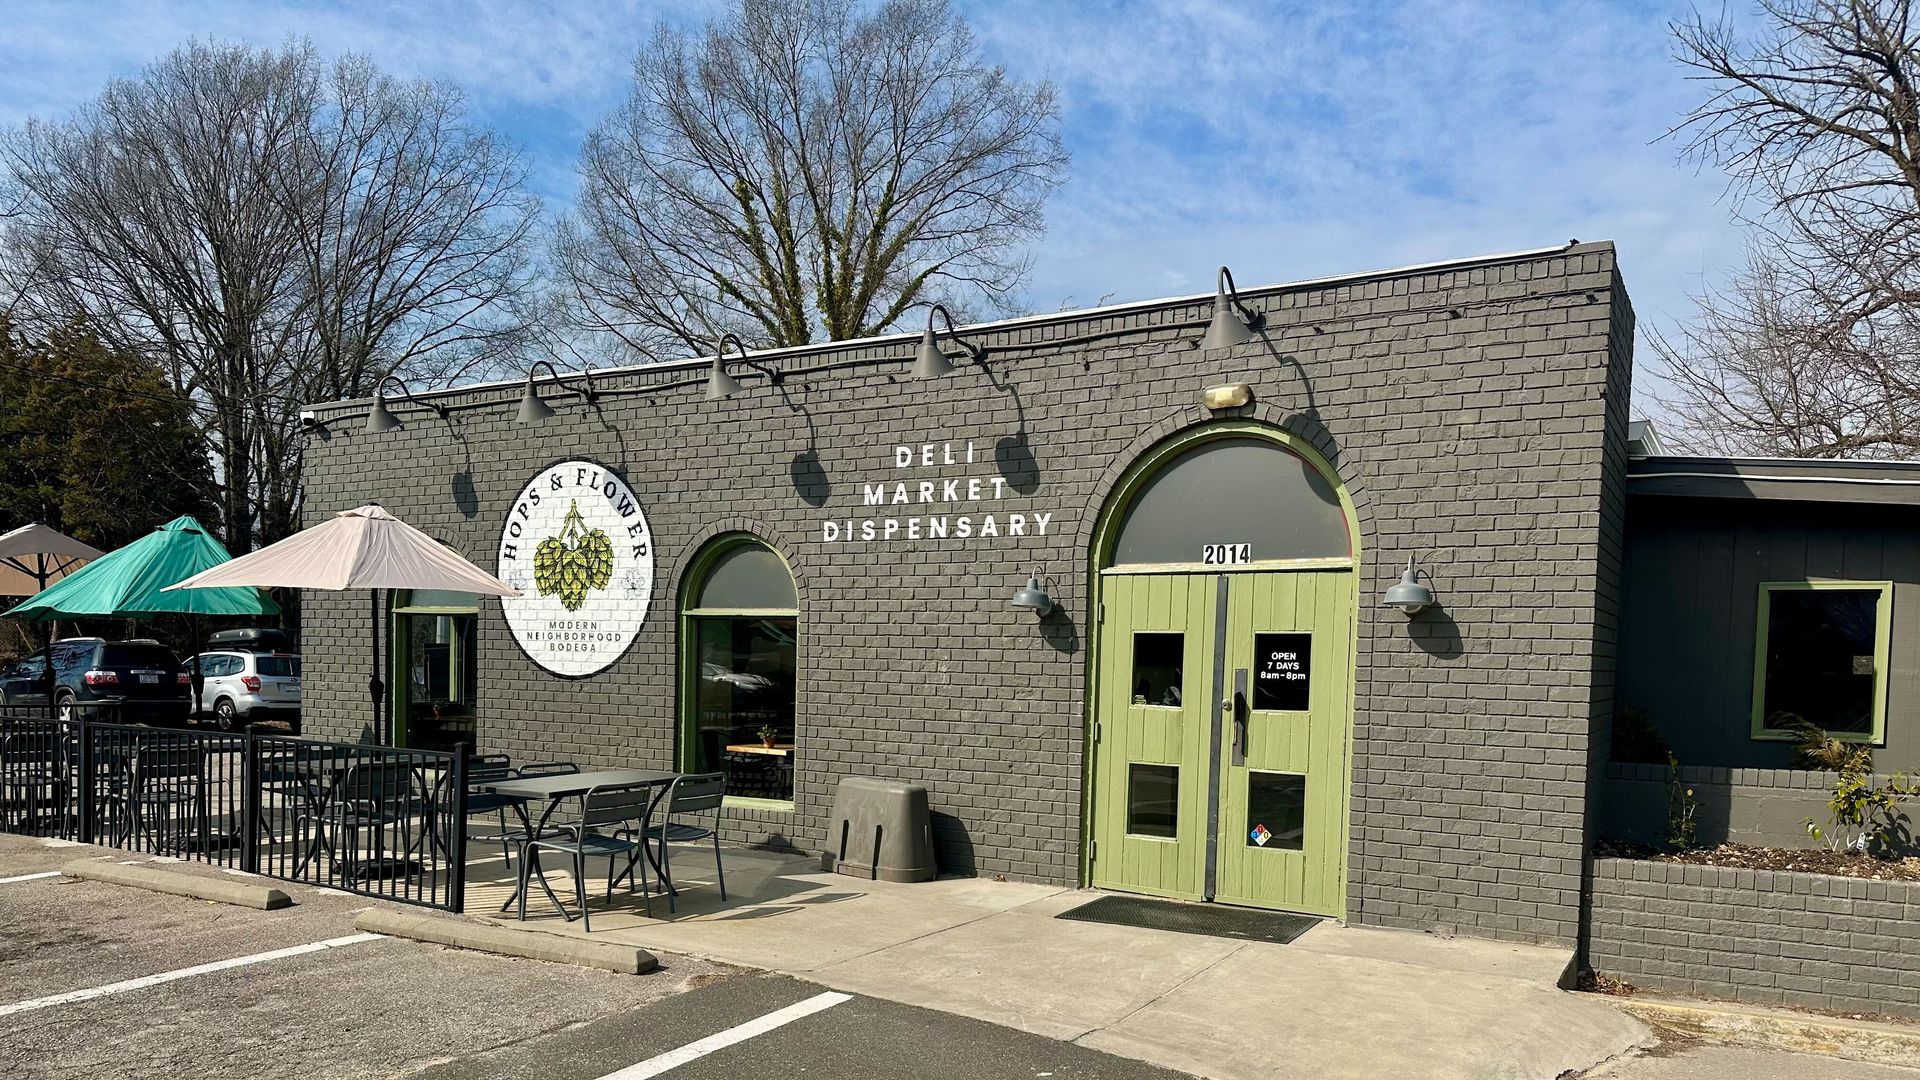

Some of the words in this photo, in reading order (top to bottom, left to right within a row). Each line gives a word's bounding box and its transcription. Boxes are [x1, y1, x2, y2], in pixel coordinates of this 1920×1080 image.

[895, 441, 974, 468] DELI
[863, 477, 1007, 505] MARKET
[504, 487, 541, 560] HOPS
[550, 473, 563, 491] &
[576, 468, 647, 560] FLOWER
[823, 512, 1052, 542] DISPENSARY
[1204, 544, 1250, 564] 2014
[549, 621, 597, 630] MODERN
[527, 632, 621, 641] NEIGHBORHOOD
[550, 643, 596, 652] BODEGA
[1271, 652, 1296, 660] OPEN
[1267, 661, 1273, 669] 7
[1276, 662, 1299, 670] DAYS
